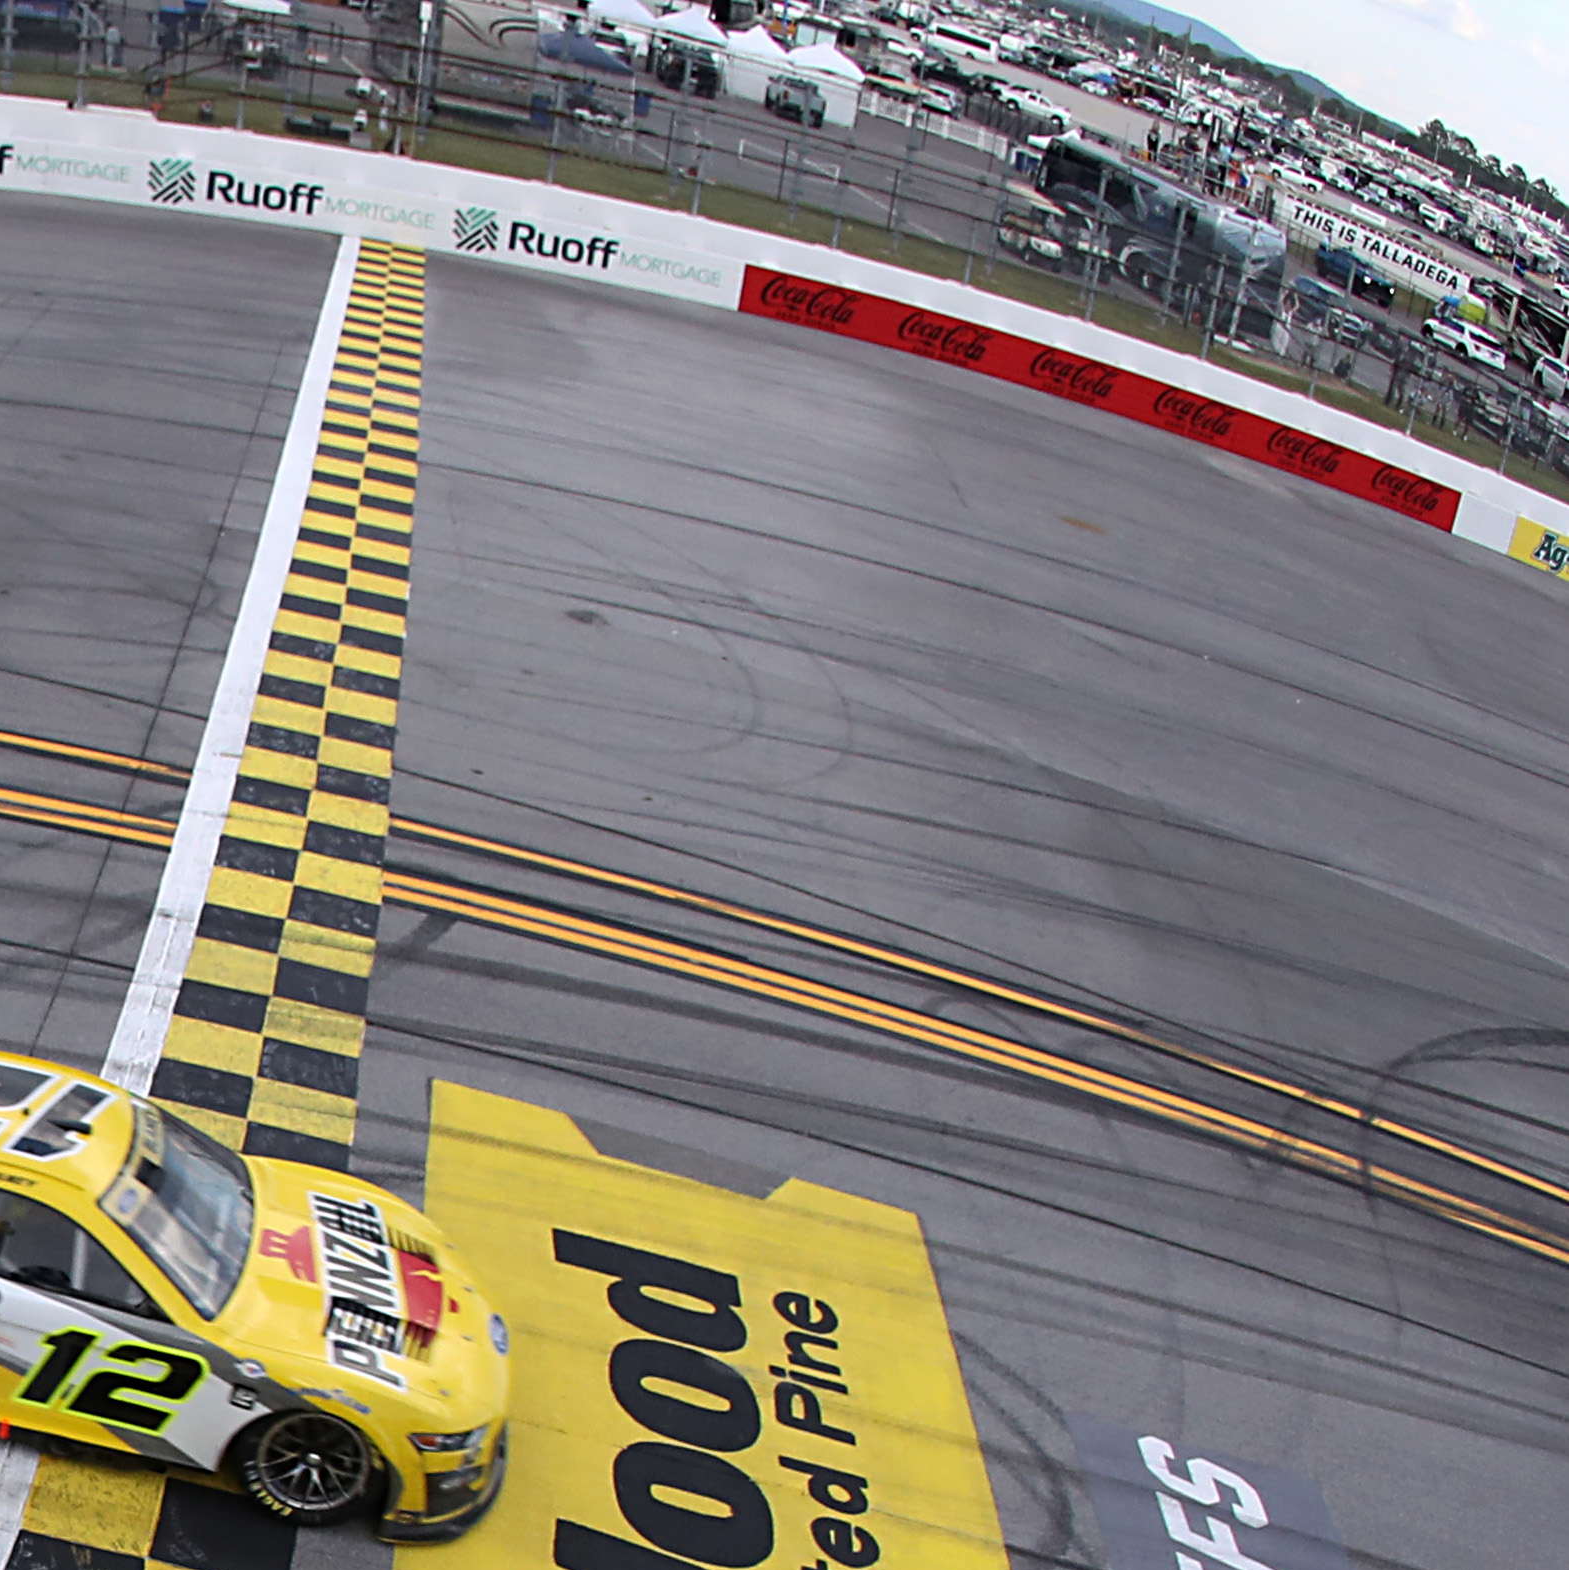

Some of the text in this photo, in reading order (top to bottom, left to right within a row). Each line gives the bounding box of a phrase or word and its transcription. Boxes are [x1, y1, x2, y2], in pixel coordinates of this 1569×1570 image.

[16, 153, 131, 184] MORTGAGE
[206, 170, 436, 231] Ruoff MORTGAGE
[508, 221, 723, 288] Ruoff MORTGAGE
[1293, 206, 1458, 291] THIS IS TALLADEGA
[761, 275, 858, 324] Coca-Cola
[898, 311, 994, 362] Coca-Cola
[1030, 350, 1122, 398] Coca-Cola
[1153, 388, 1237, 438] Coca-Cola
[14, 1326, 211, 1436] 12
[774, 1292, 855, 1445] Pine
